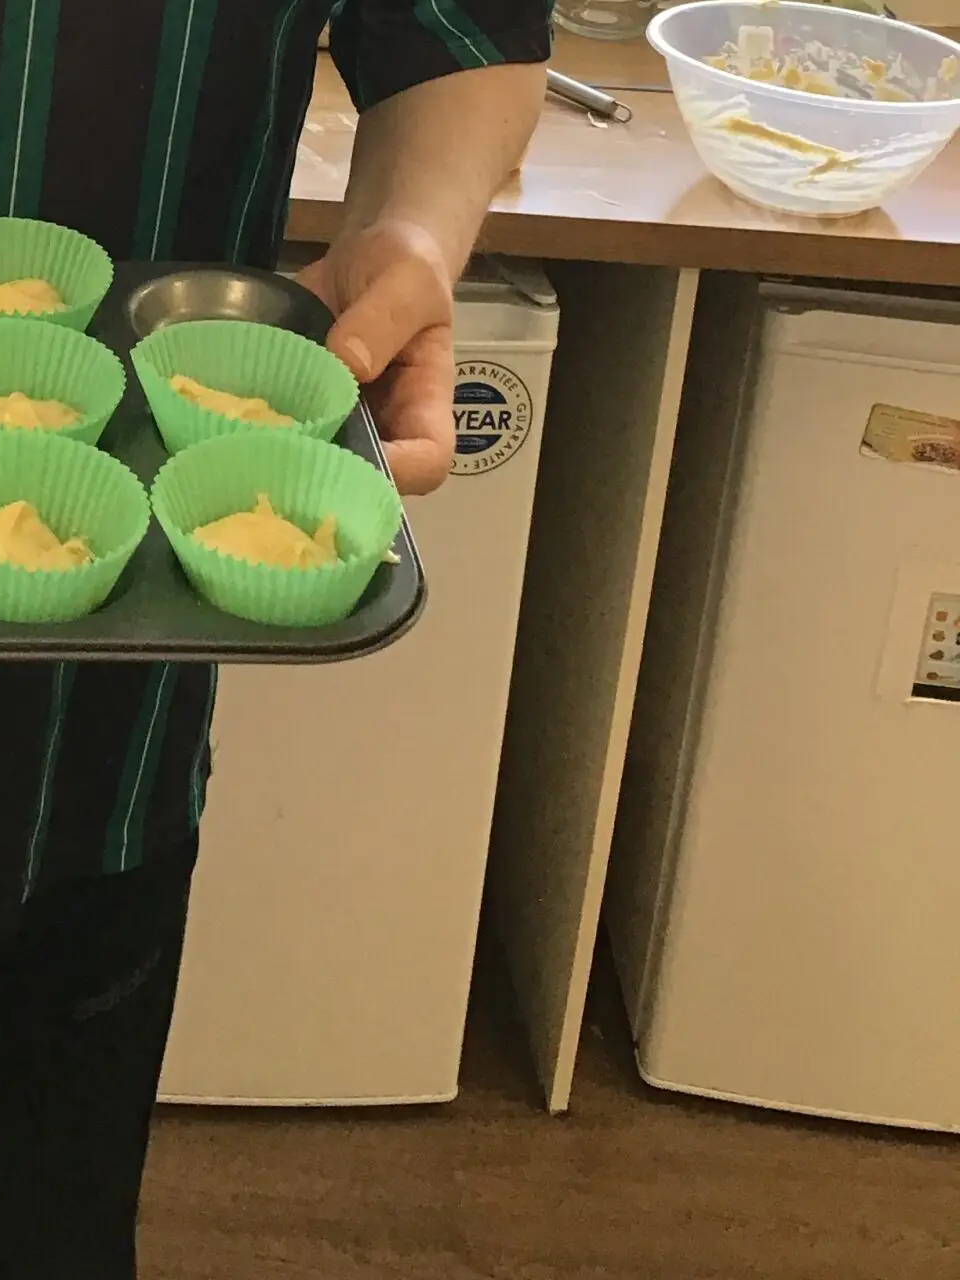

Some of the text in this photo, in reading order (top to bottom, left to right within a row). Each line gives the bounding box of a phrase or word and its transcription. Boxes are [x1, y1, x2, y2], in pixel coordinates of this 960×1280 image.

[457, 366, 518, 392] ARANTEE
[451, 410, 512, 430] YEAR
[473, 403, 527, 469] GUARANTEE
